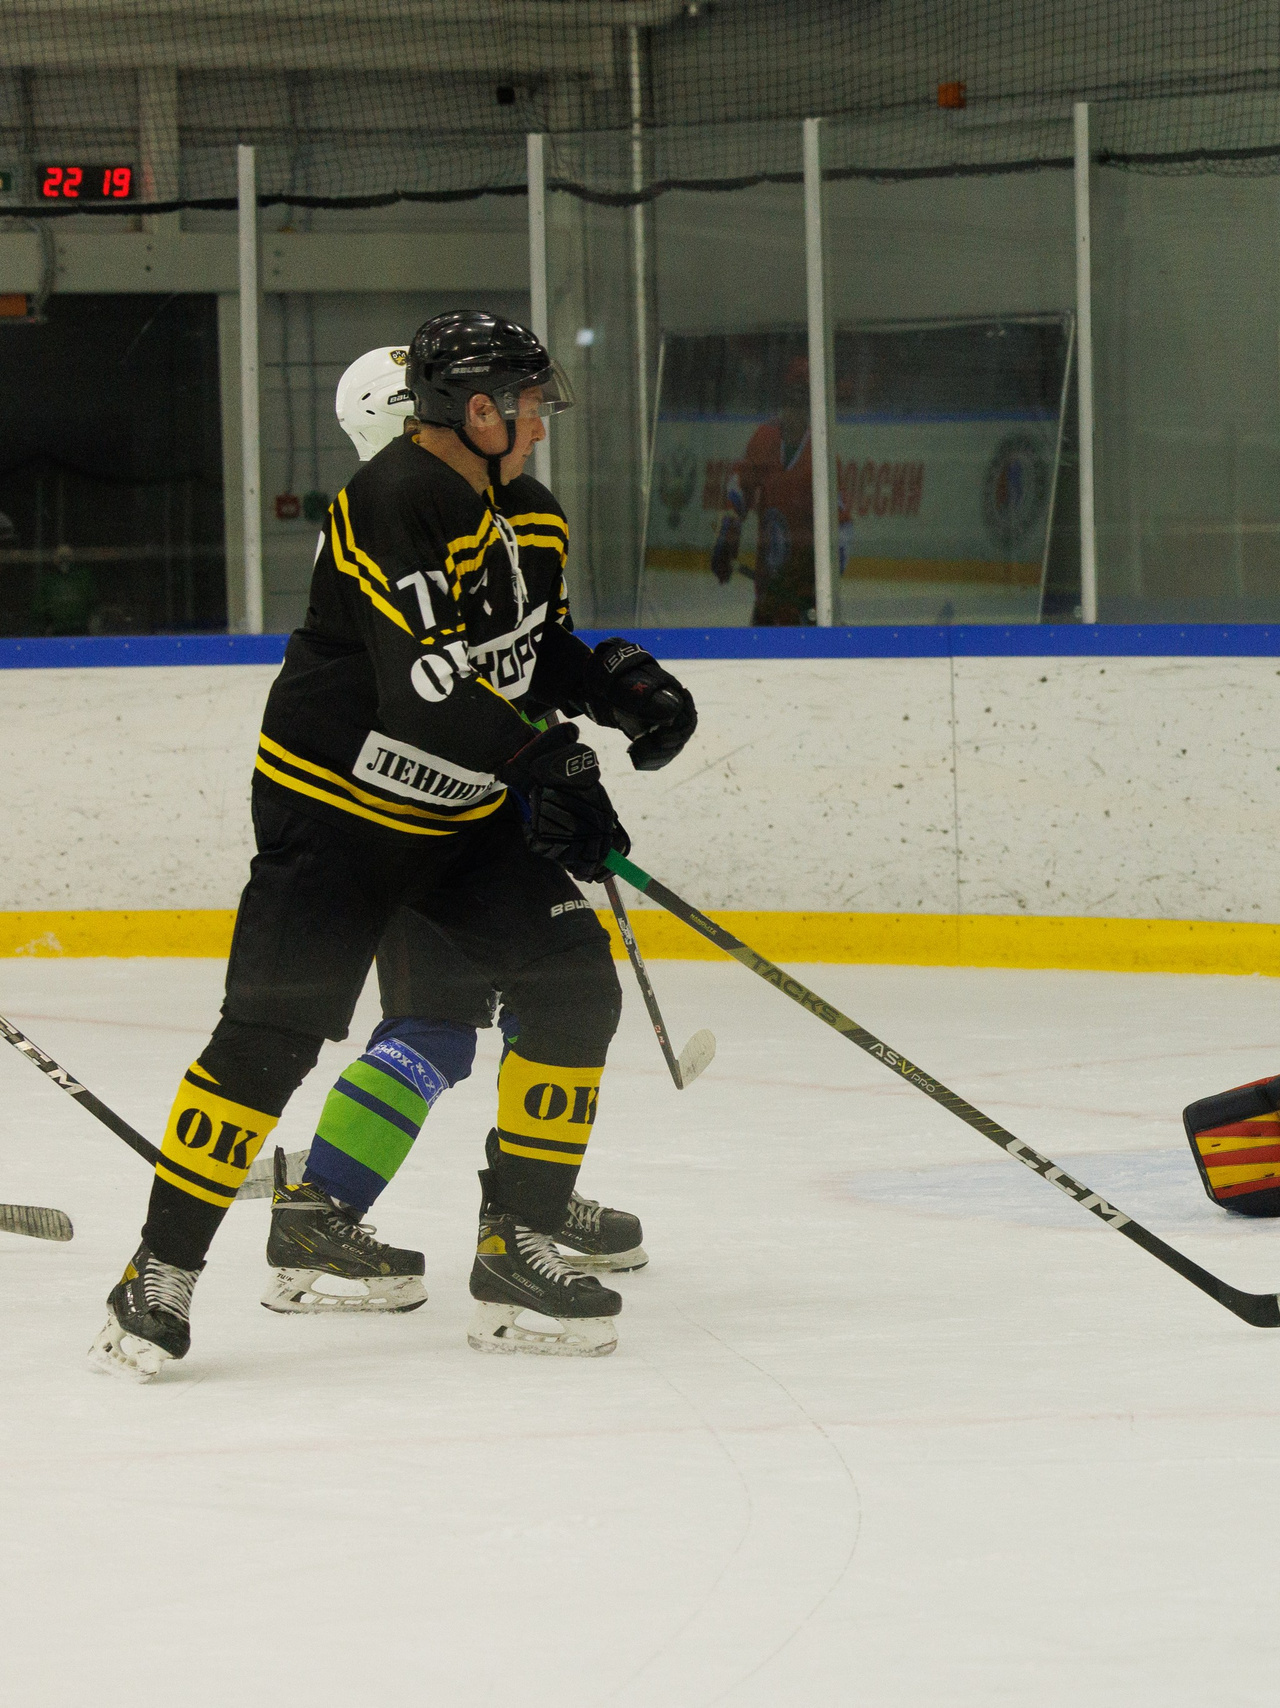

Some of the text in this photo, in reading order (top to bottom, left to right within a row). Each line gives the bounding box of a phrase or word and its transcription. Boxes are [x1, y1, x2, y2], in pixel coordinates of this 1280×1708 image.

[43, 167, 131, 198] 22 19
[751, 952, 840, 1025] TACKS
[911, 1073, 936, 1093] PRO
[1005, 1137, 1132, 1230] CCM
